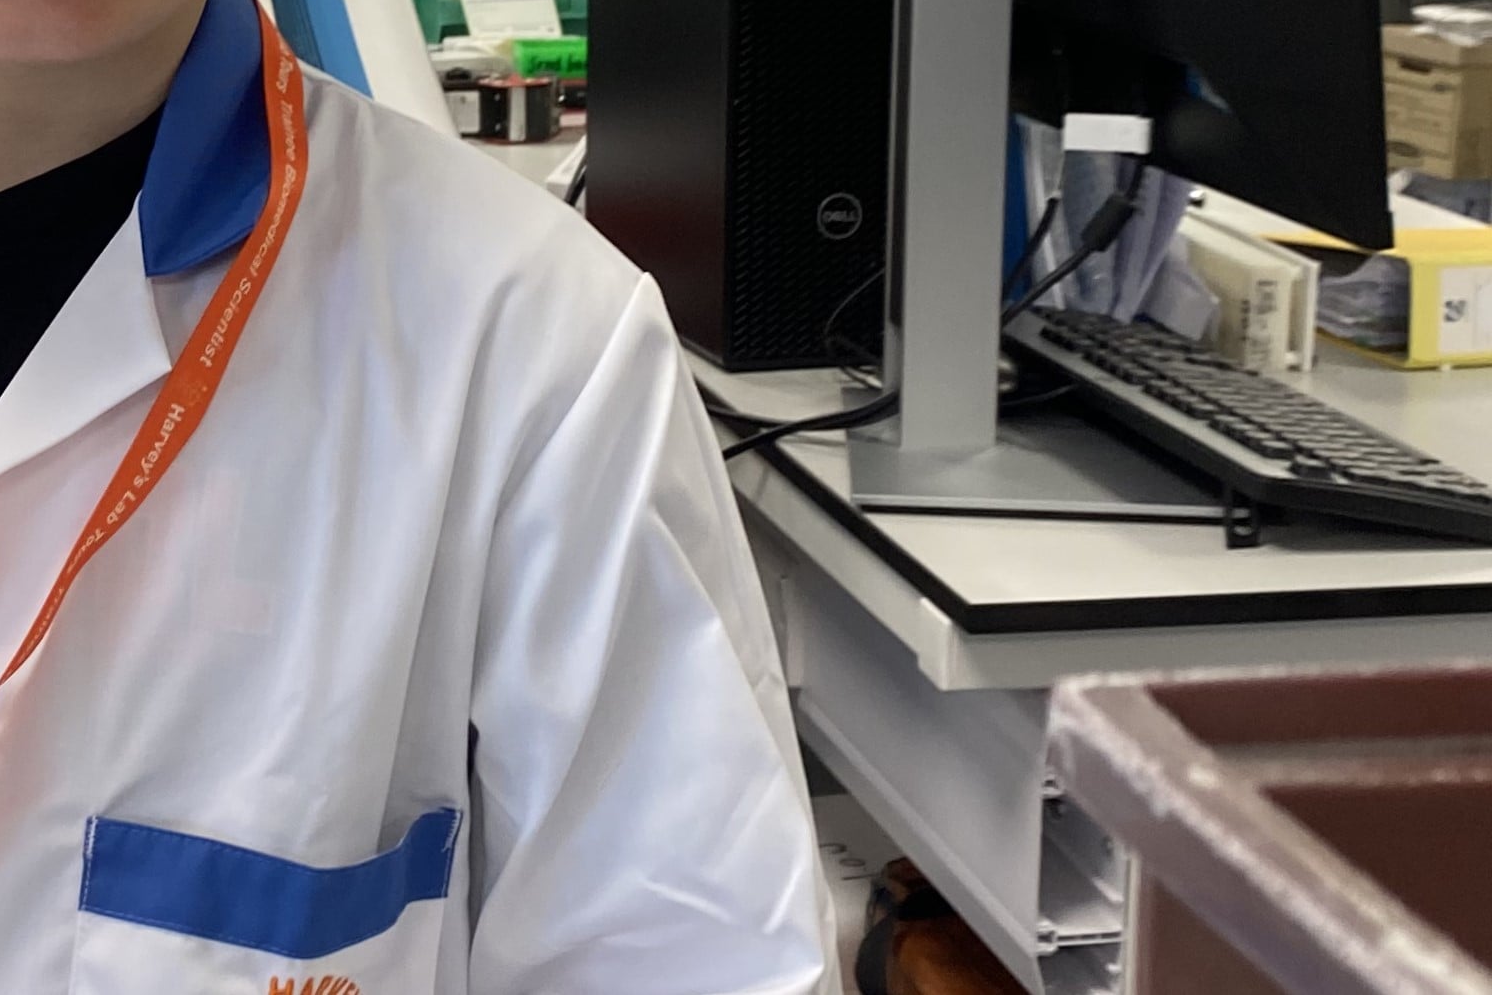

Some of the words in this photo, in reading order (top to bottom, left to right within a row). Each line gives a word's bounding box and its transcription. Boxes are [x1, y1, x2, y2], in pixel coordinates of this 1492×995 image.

[199, 277, 252, 368] Scientist
[133, 403, 186, 489] Harvey's
[106, 490, 137, 525] Lab
